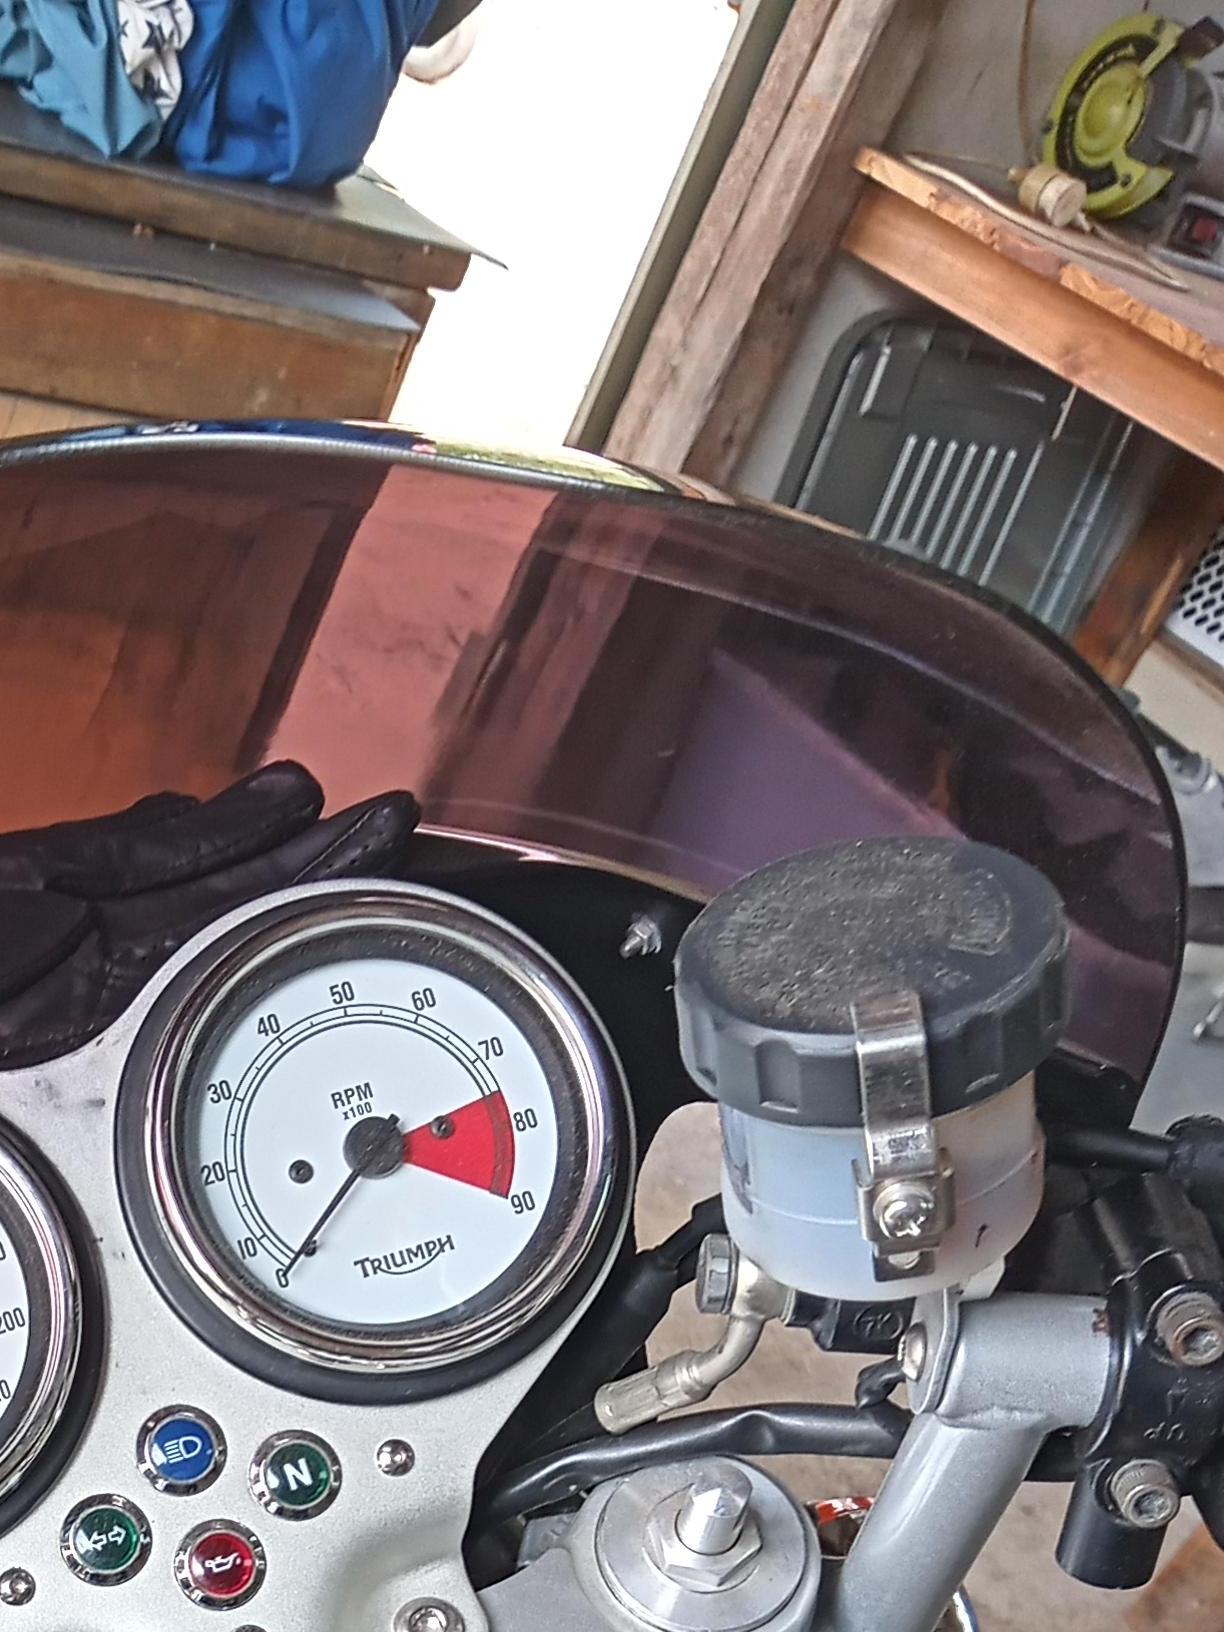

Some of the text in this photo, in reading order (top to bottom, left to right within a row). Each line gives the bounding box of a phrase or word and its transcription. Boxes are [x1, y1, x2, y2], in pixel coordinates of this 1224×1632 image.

[329, 981, 355, 1005] 50
[411, 987, 437, 1012] 60
[257, 1012, 281, 1038] 40
[478, 1036, 504, 1060] 70
[208, 1079, 233, 1104] 30
[331, 1082, 374, 1110] RPM
[342, 1101, 373, 1121] x100
[513, 1107, 538, 1132] 80
[201, 1161, 226, 1186] 20
[510, 1190, 536, 1215] 90
[237, 1236, 257, 1260] 10
[353, 1235, 455, 1279] TRIUMPH
[283, 1458, 313, 1491] N
